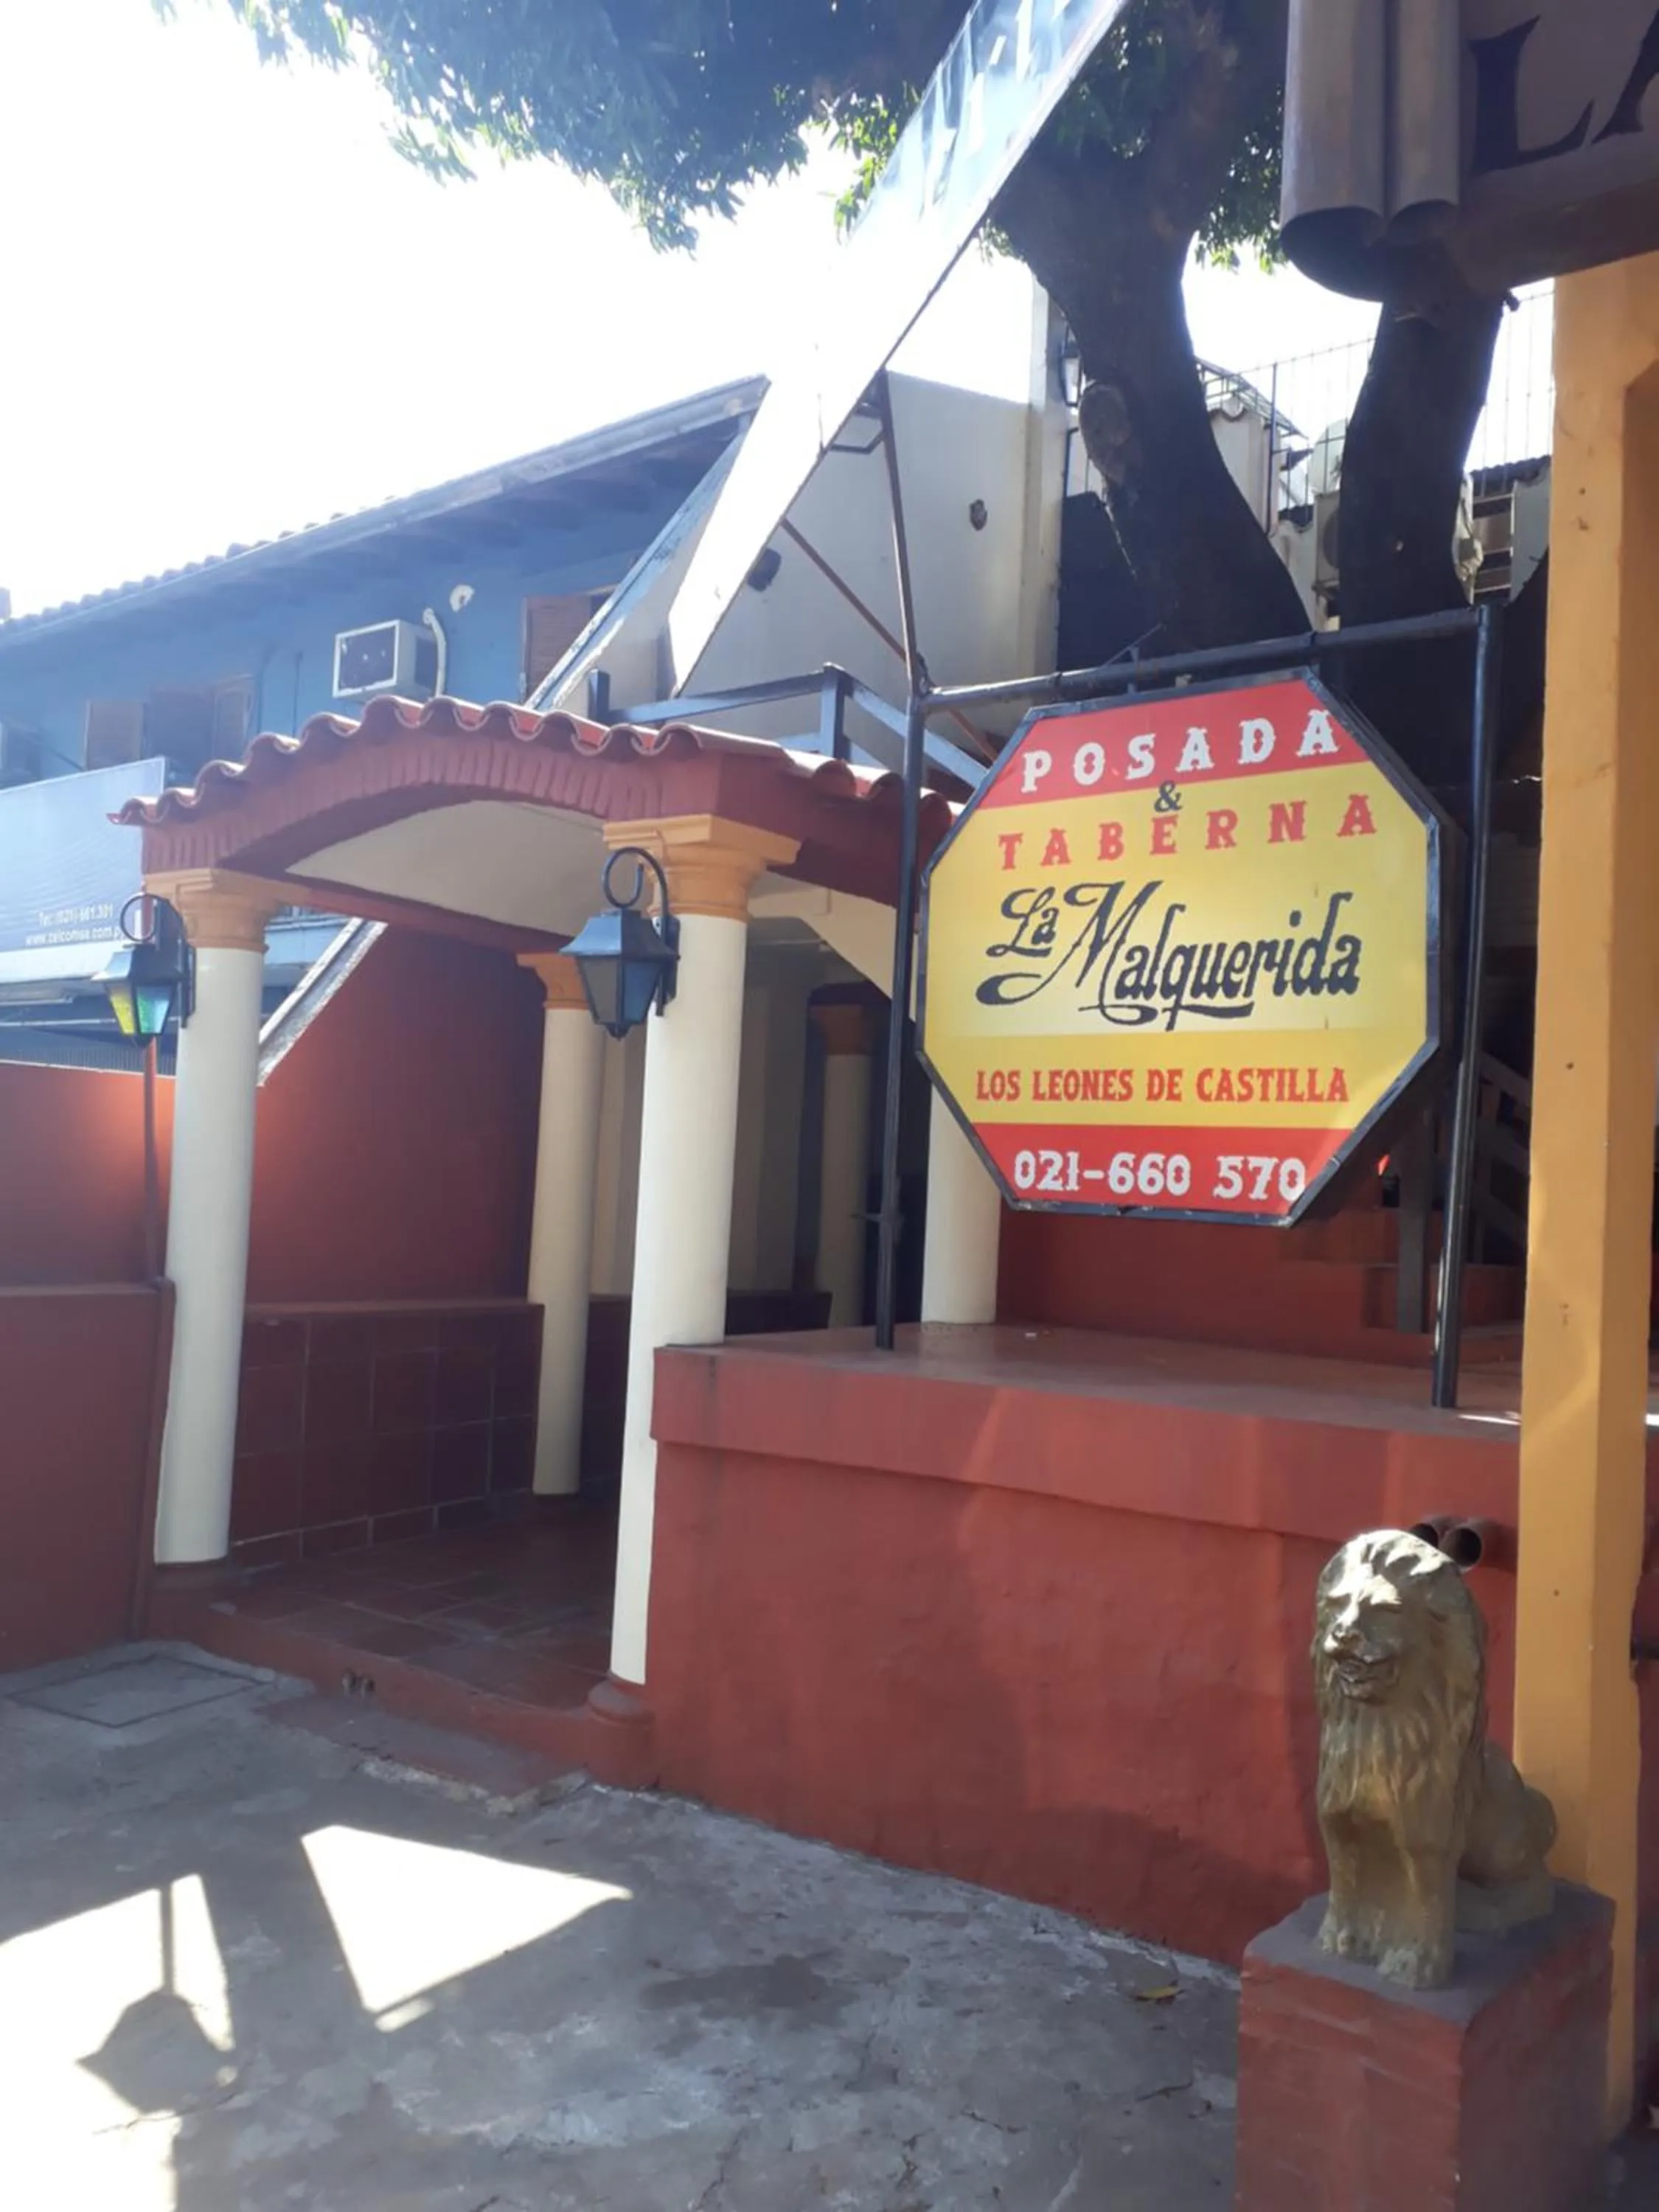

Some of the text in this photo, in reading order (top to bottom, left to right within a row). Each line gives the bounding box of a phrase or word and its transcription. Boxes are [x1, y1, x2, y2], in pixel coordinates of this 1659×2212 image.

[1020, 709, 1340, 793] POSADA
[1155, 780, 1182, 813] &
[998, 793, 1377, 870] TABERNA
[976, 881, 1363, 1031] La Malquerida
[977, 1068, 1349, 1103] LOS LEONES DE CASTILLA
[1015, 1150, 1307, 1202] 021-660 570
